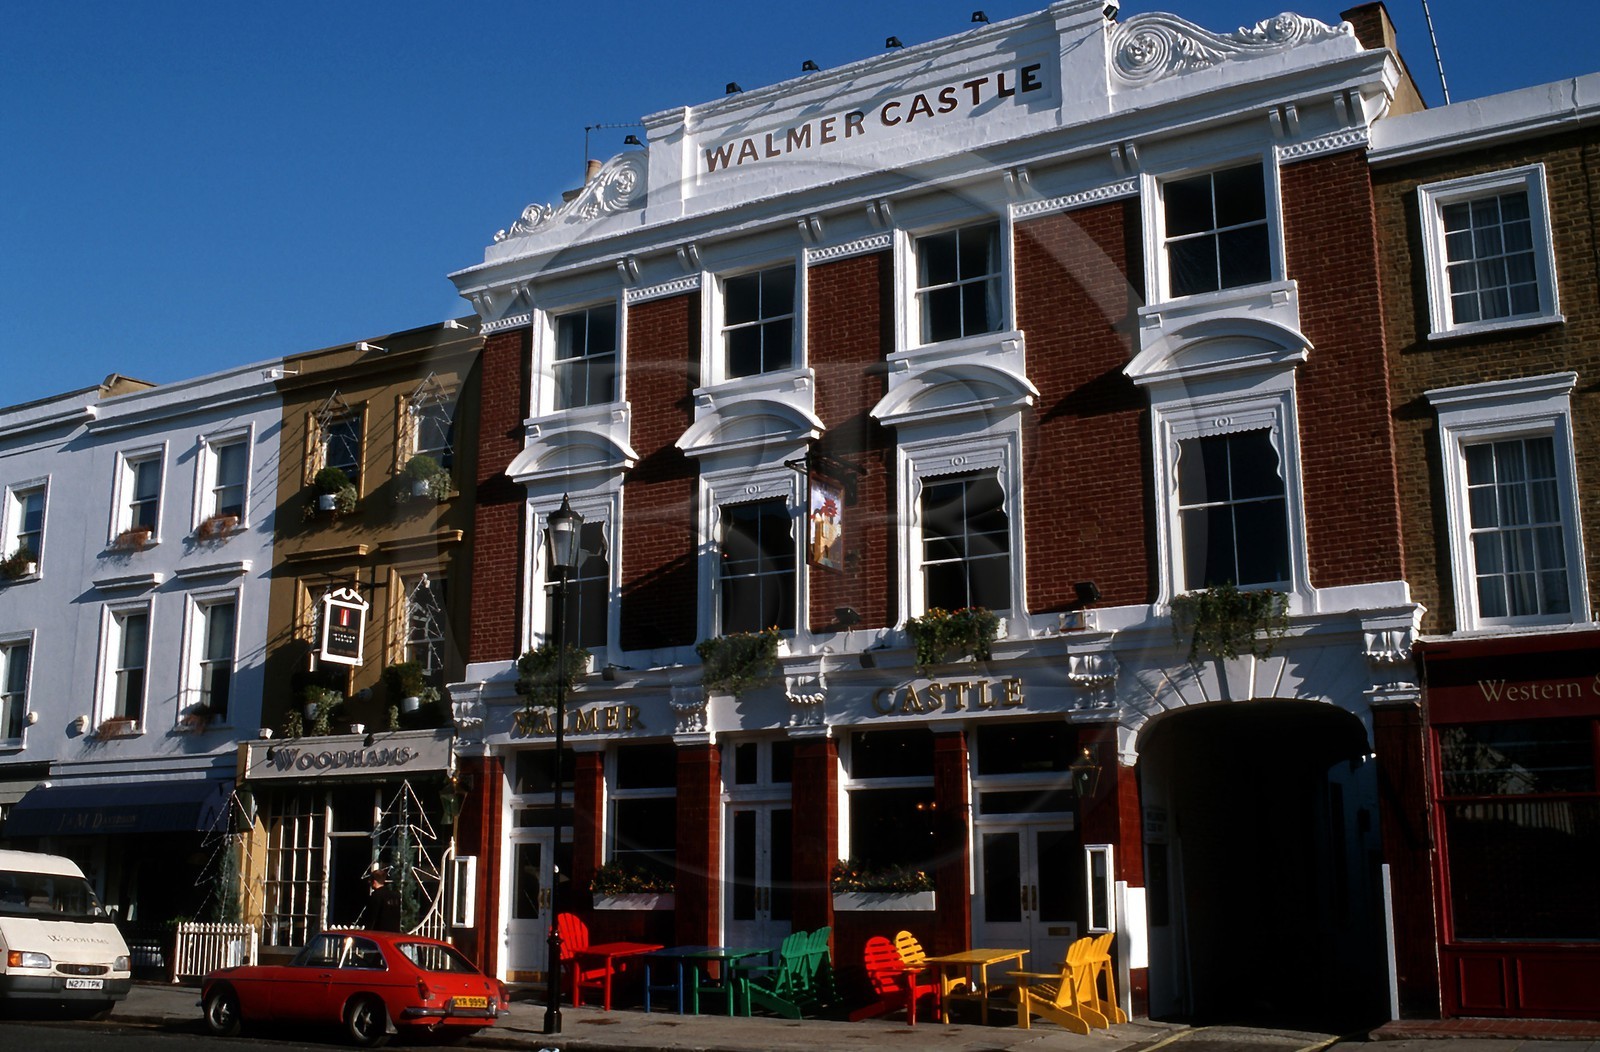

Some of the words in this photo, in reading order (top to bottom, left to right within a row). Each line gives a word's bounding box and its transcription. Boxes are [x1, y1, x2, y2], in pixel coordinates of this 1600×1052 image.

[705, 111, 865, 173] WALMER
[880, 63, 1043, 127] CASTLE
[872, 678, 1025, 715] CASTLE
[1478, 679, 1582, 702] Western
